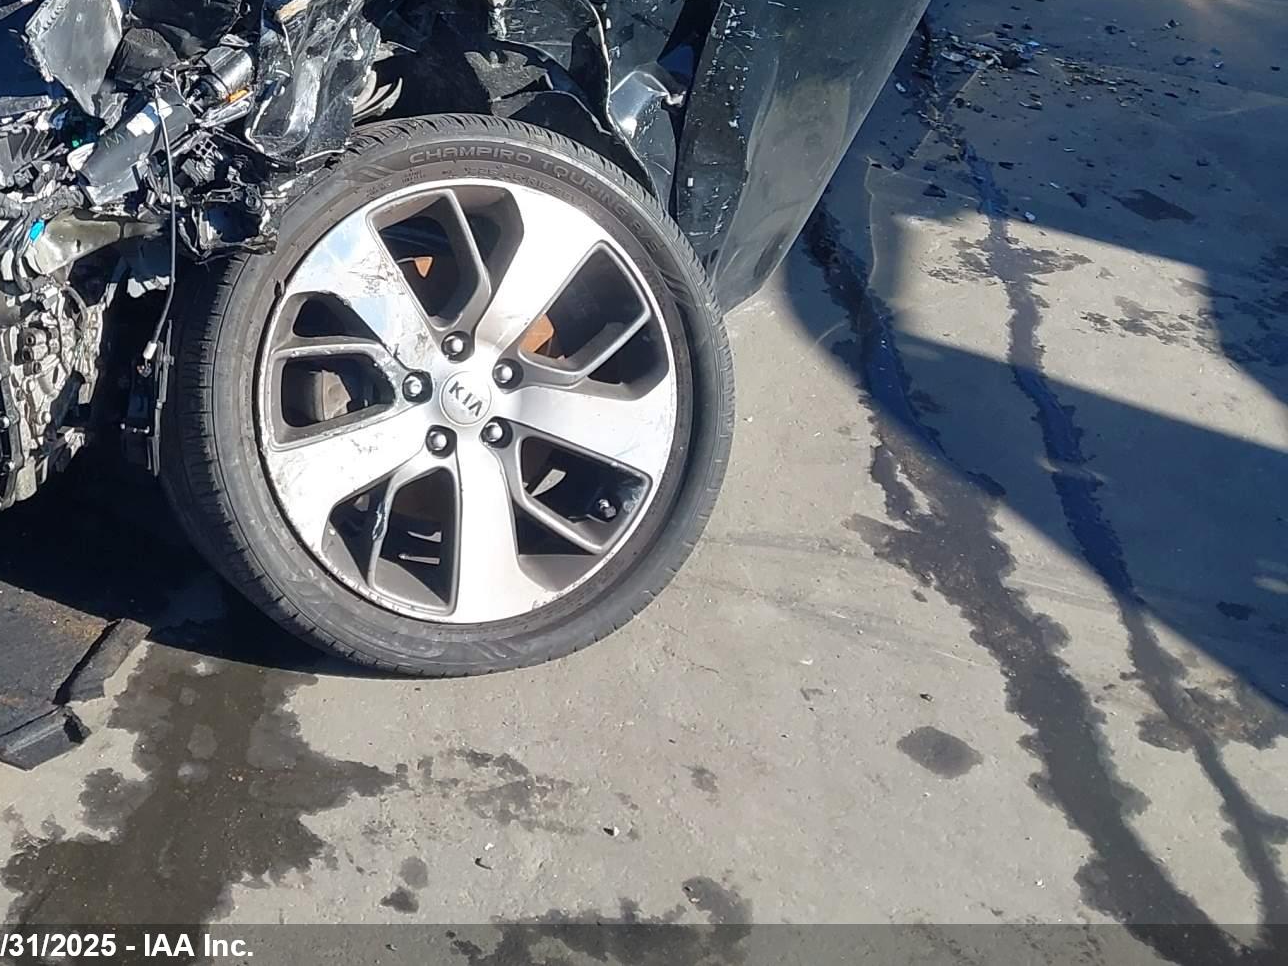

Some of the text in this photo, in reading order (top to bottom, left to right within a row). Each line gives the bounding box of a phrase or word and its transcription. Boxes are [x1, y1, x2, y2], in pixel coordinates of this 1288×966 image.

[409, 145, 532, 165] CHAMPIRO
[540, 157, 631, 218] TOURING
[448, 380, 483, 417] KIA
